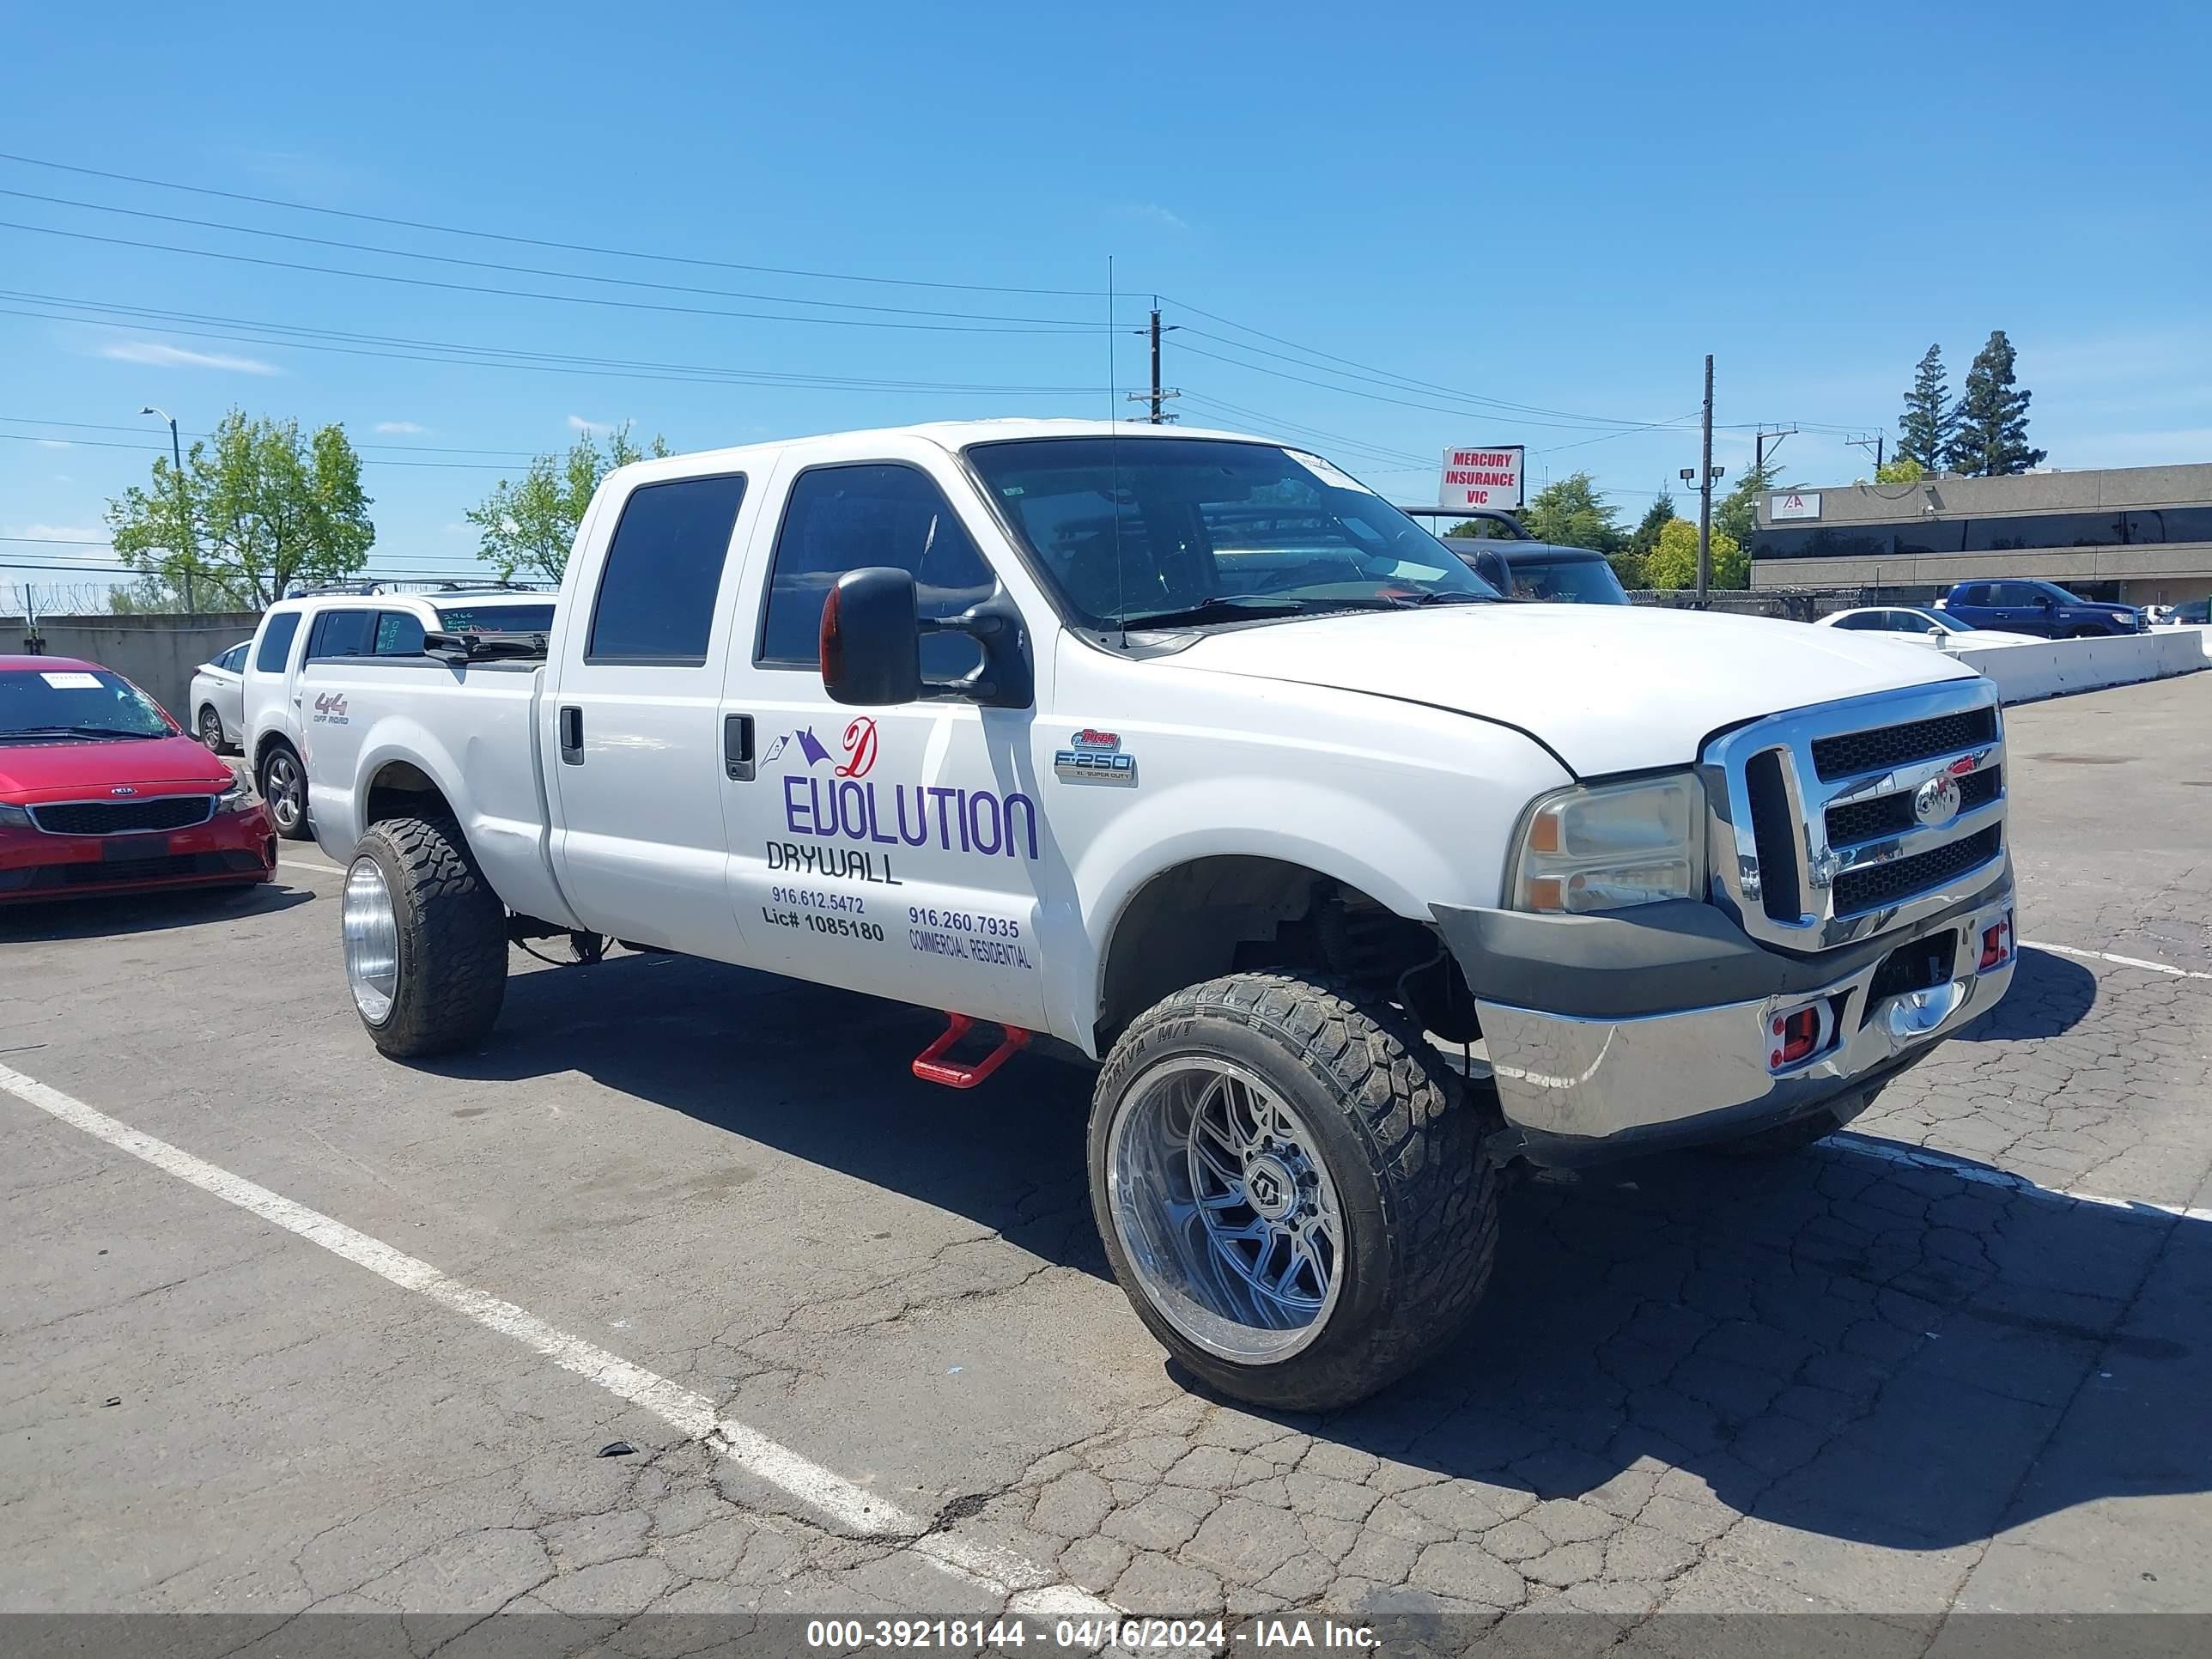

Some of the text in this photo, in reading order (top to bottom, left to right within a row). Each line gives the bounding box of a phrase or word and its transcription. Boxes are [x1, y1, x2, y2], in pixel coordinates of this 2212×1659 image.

[1453, 453, 1512, 467] MERCURY
[1445, 471, 1515, 487] INSURANCE
[1467, 490, 1488, 504] VIC
[315, 692, 348, 716] 4x4
[835, 716, 878, 778] D
[766, 841, 902, 885] DRYWALL
[772, 886, 865, 914] 916.612.5472
[762, 906, 884, 941] Lic# 1085180
[908, 906, 1019, 939] 916.260.7935
[908, 928, 1032, 969] COMMERCIAL RESIDENTIAL
